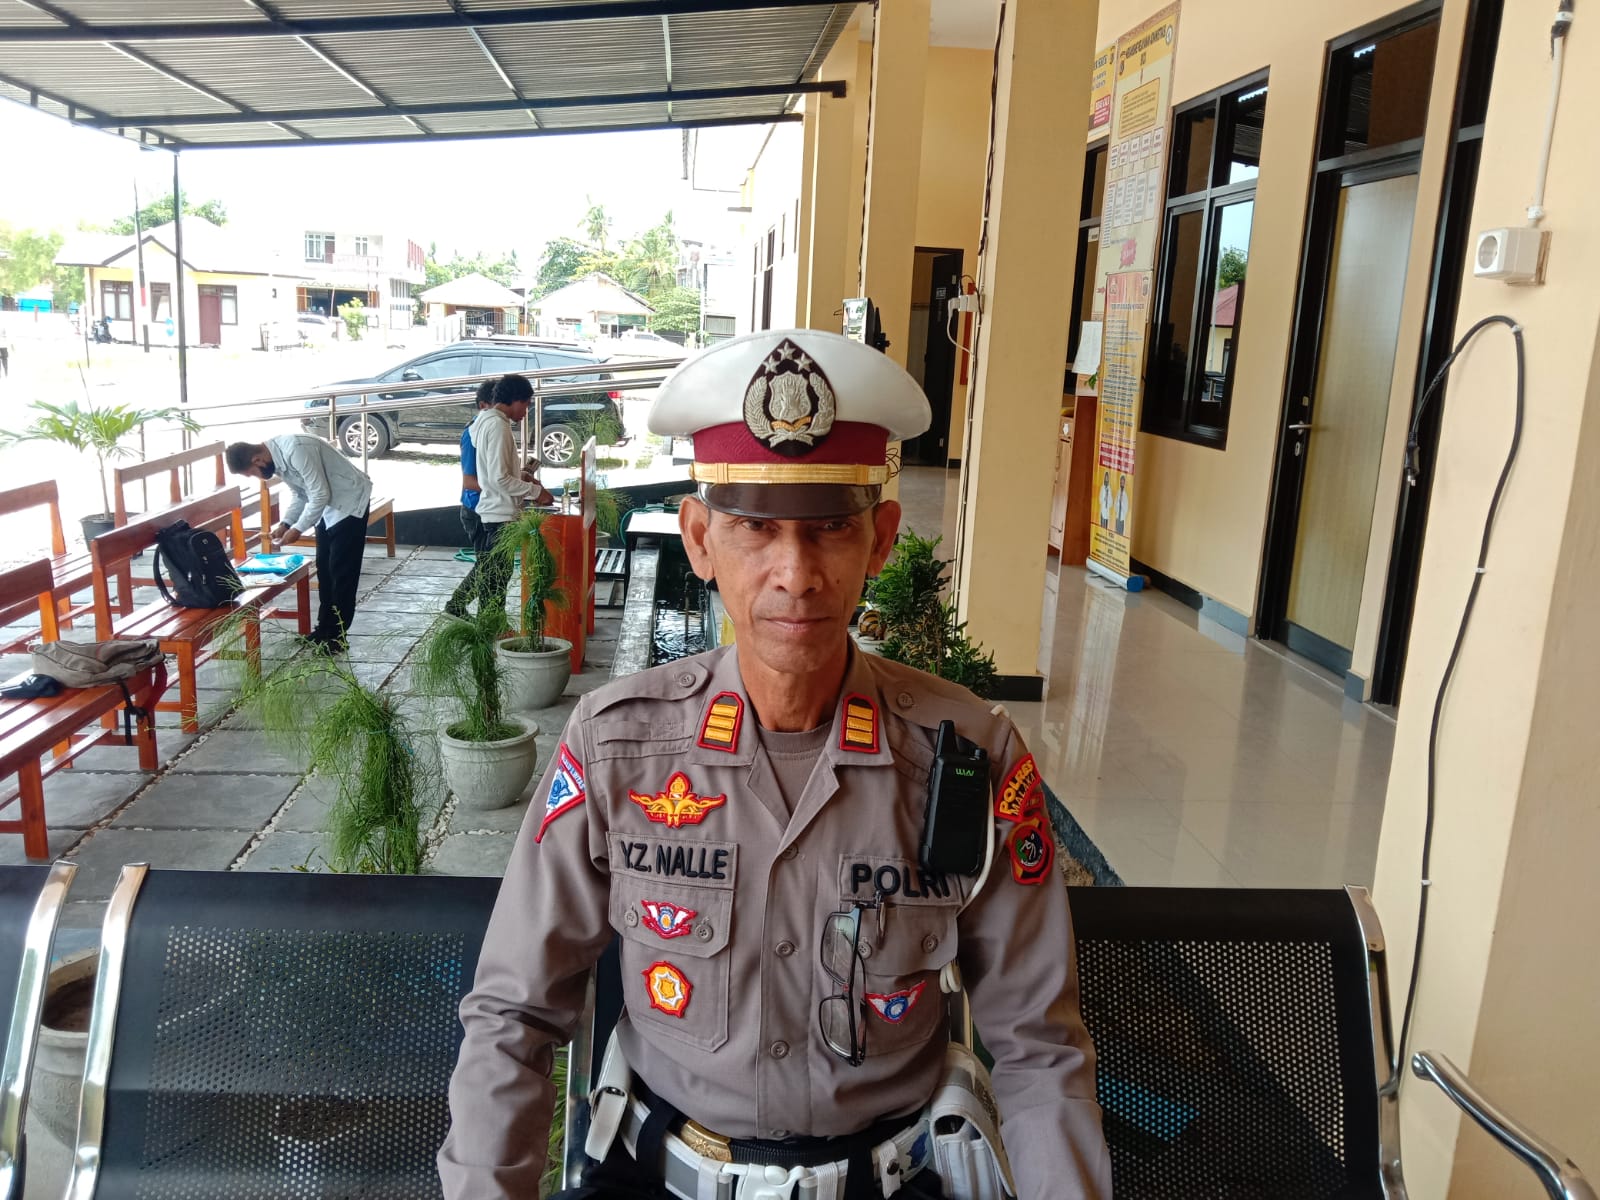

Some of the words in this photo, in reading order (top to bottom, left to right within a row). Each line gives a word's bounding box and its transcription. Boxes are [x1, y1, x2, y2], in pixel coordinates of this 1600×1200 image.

[999, 760, 1035, 815] POLRES
[1010, 772, 1036, 816] MALAKA
[656, 844, 730, 880] NALLE
